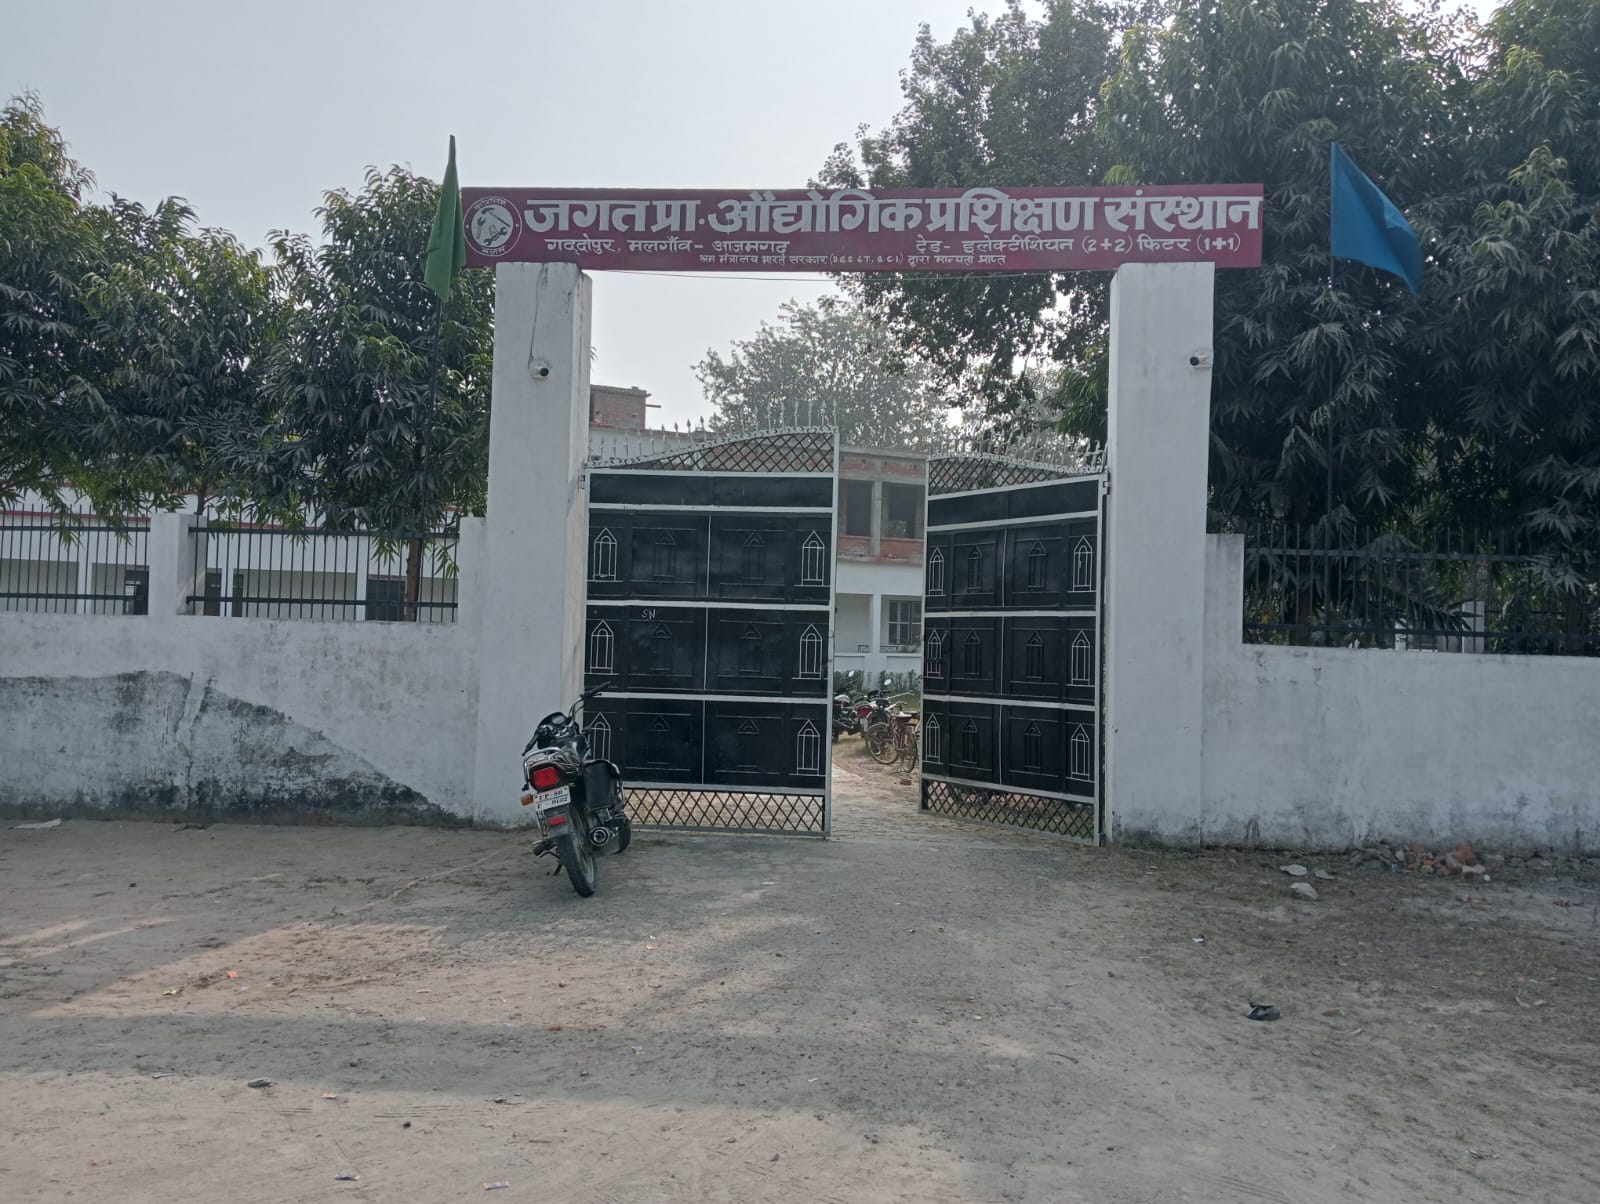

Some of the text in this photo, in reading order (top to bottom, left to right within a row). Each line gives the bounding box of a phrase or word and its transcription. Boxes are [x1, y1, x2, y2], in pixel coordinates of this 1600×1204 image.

[925, 187, 1099, 234] प्रशिक्षण
[1104, 189, 1263, 232] संस्थान
[1082, 234, 1132, 254] (2+2)
[1136, 233, 1191, 252] फिटर
[1197, 232, 1240, 254] (1+1)
[789, 255, 828, 264] सरकार
